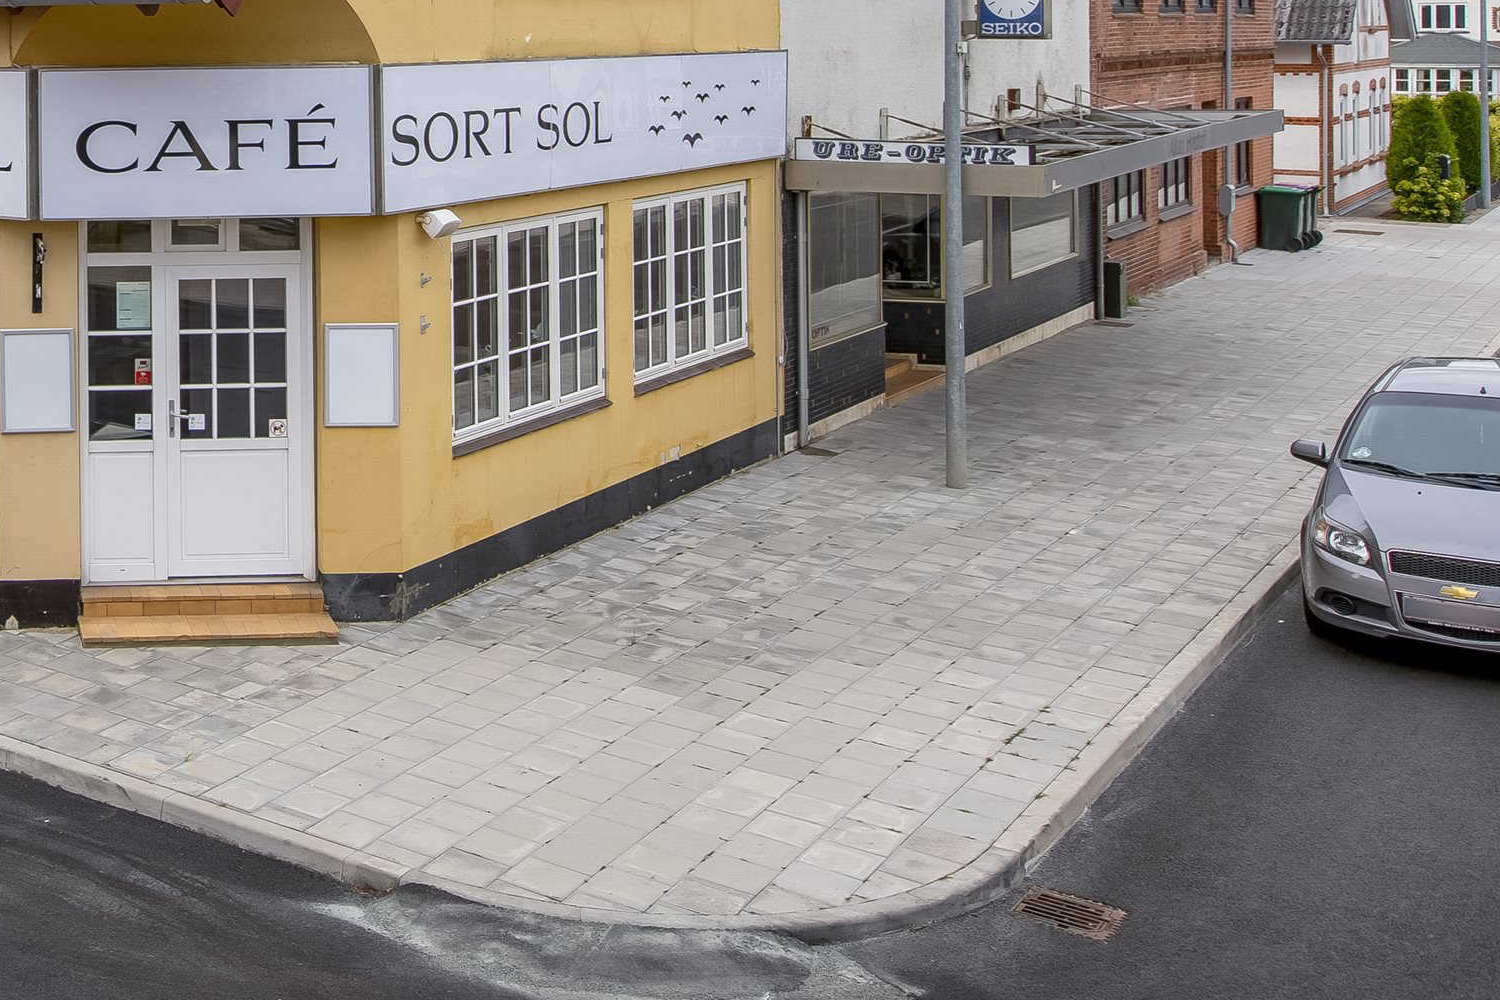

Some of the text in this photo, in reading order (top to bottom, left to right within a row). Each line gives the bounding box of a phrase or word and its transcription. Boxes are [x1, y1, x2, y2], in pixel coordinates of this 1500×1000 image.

[981, 22, 1042, 35] SEIKO
[75, 103, 338, 174] CAFÉ
[391, 101, 613, 166] SORT SOL
